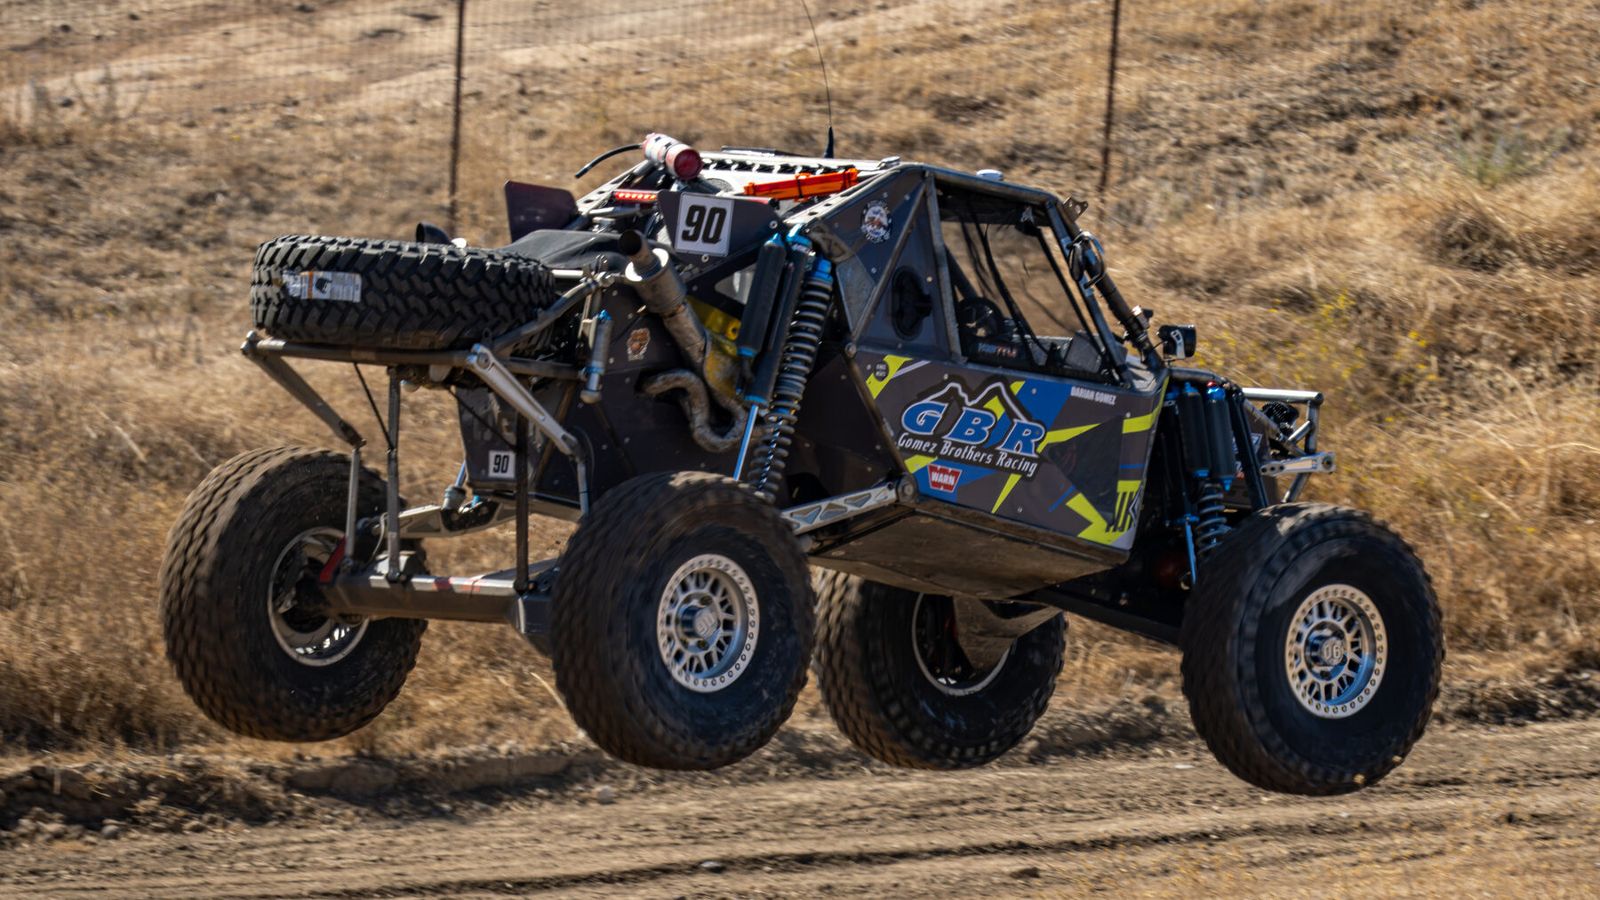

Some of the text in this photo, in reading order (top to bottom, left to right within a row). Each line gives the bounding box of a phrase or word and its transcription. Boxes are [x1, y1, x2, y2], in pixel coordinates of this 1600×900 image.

[681, 204, 727, 245] 90
[901, 400, 1046, 458] GBR
[493, 454, 510, 473] 90
[897, 432, 1039, 477] Gomez Brothers Racing
[931, 471, 956, 486] WARN
